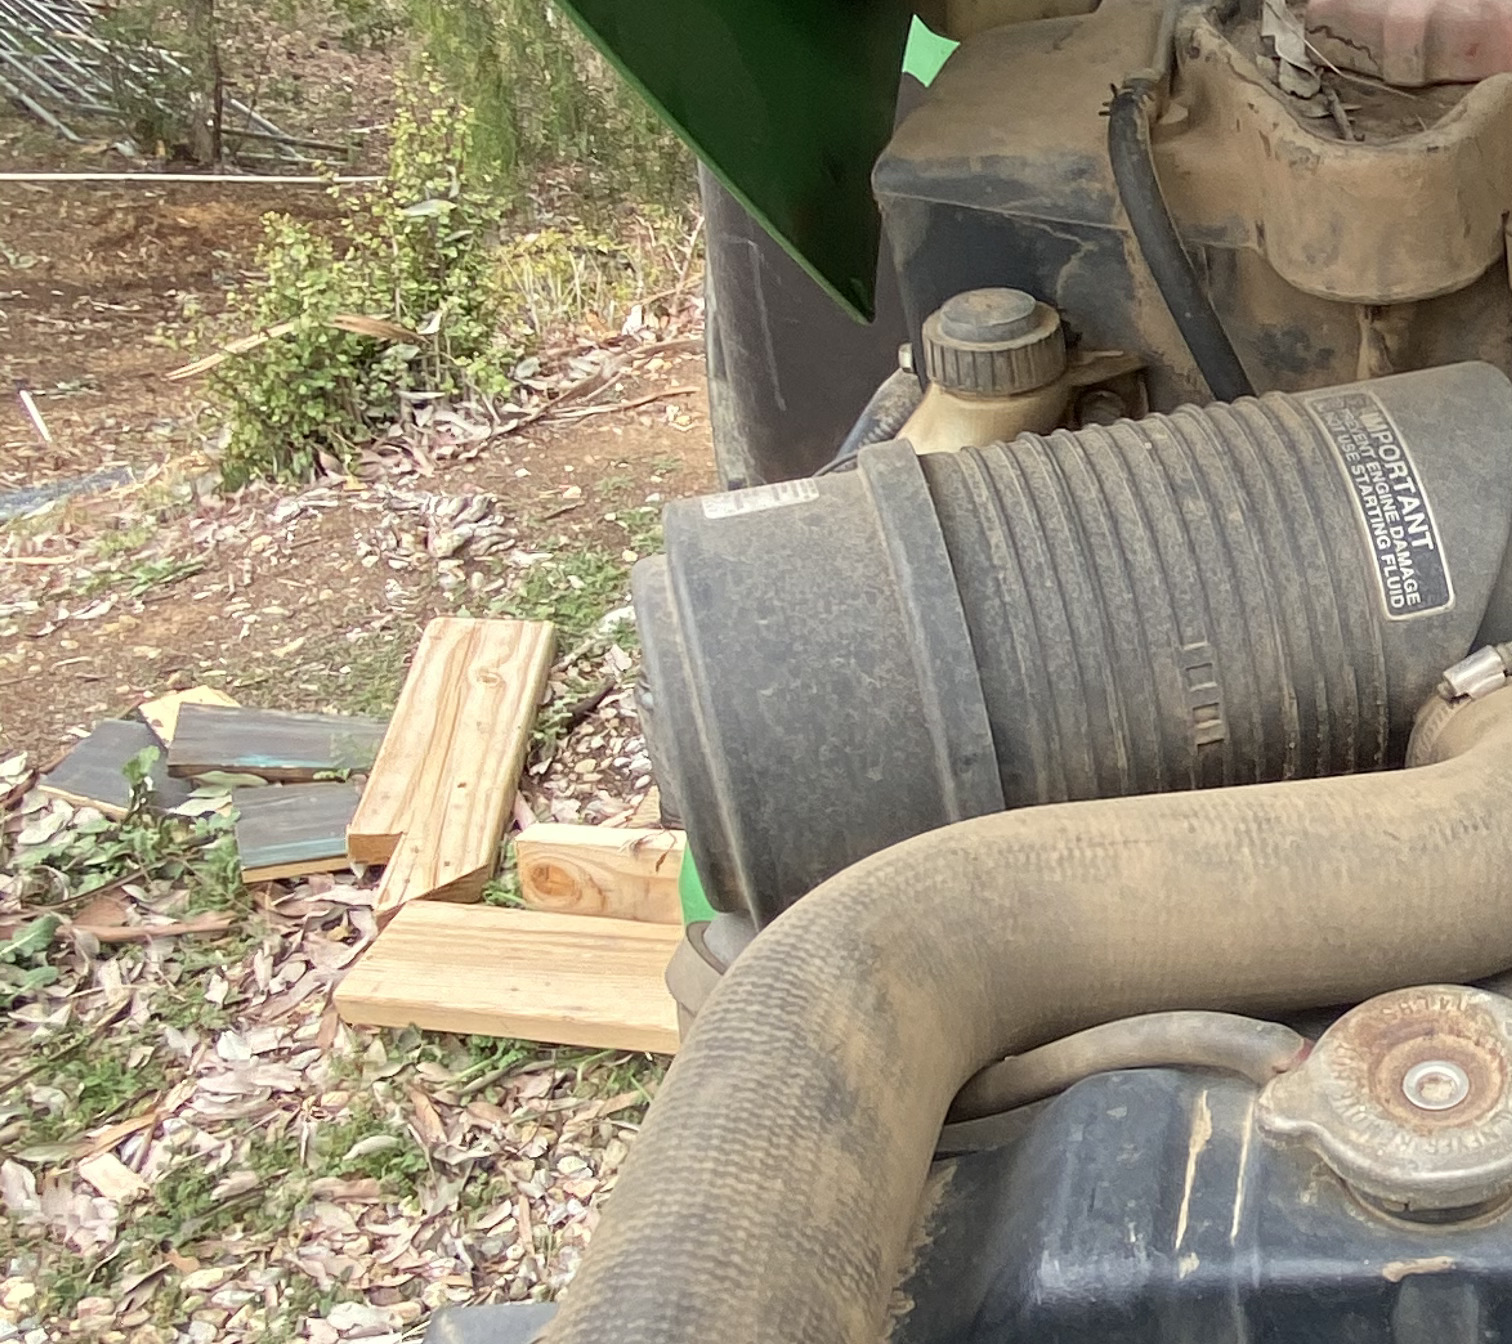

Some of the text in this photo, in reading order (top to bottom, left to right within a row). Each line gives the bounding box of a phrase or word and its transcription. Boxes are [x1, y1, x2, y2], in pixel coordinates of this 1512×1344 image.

[1337, 435, 1359, 462] USE
[1350, 465, 1390, 549] STARTING
[1381, 554, 1404, 608] FLUID
[1359, 411, 1434, 551] IMPORTANT
[1366, 462, 1401, 522] ENGINE
[1390, 526, 1421, 606] DAMAGE
